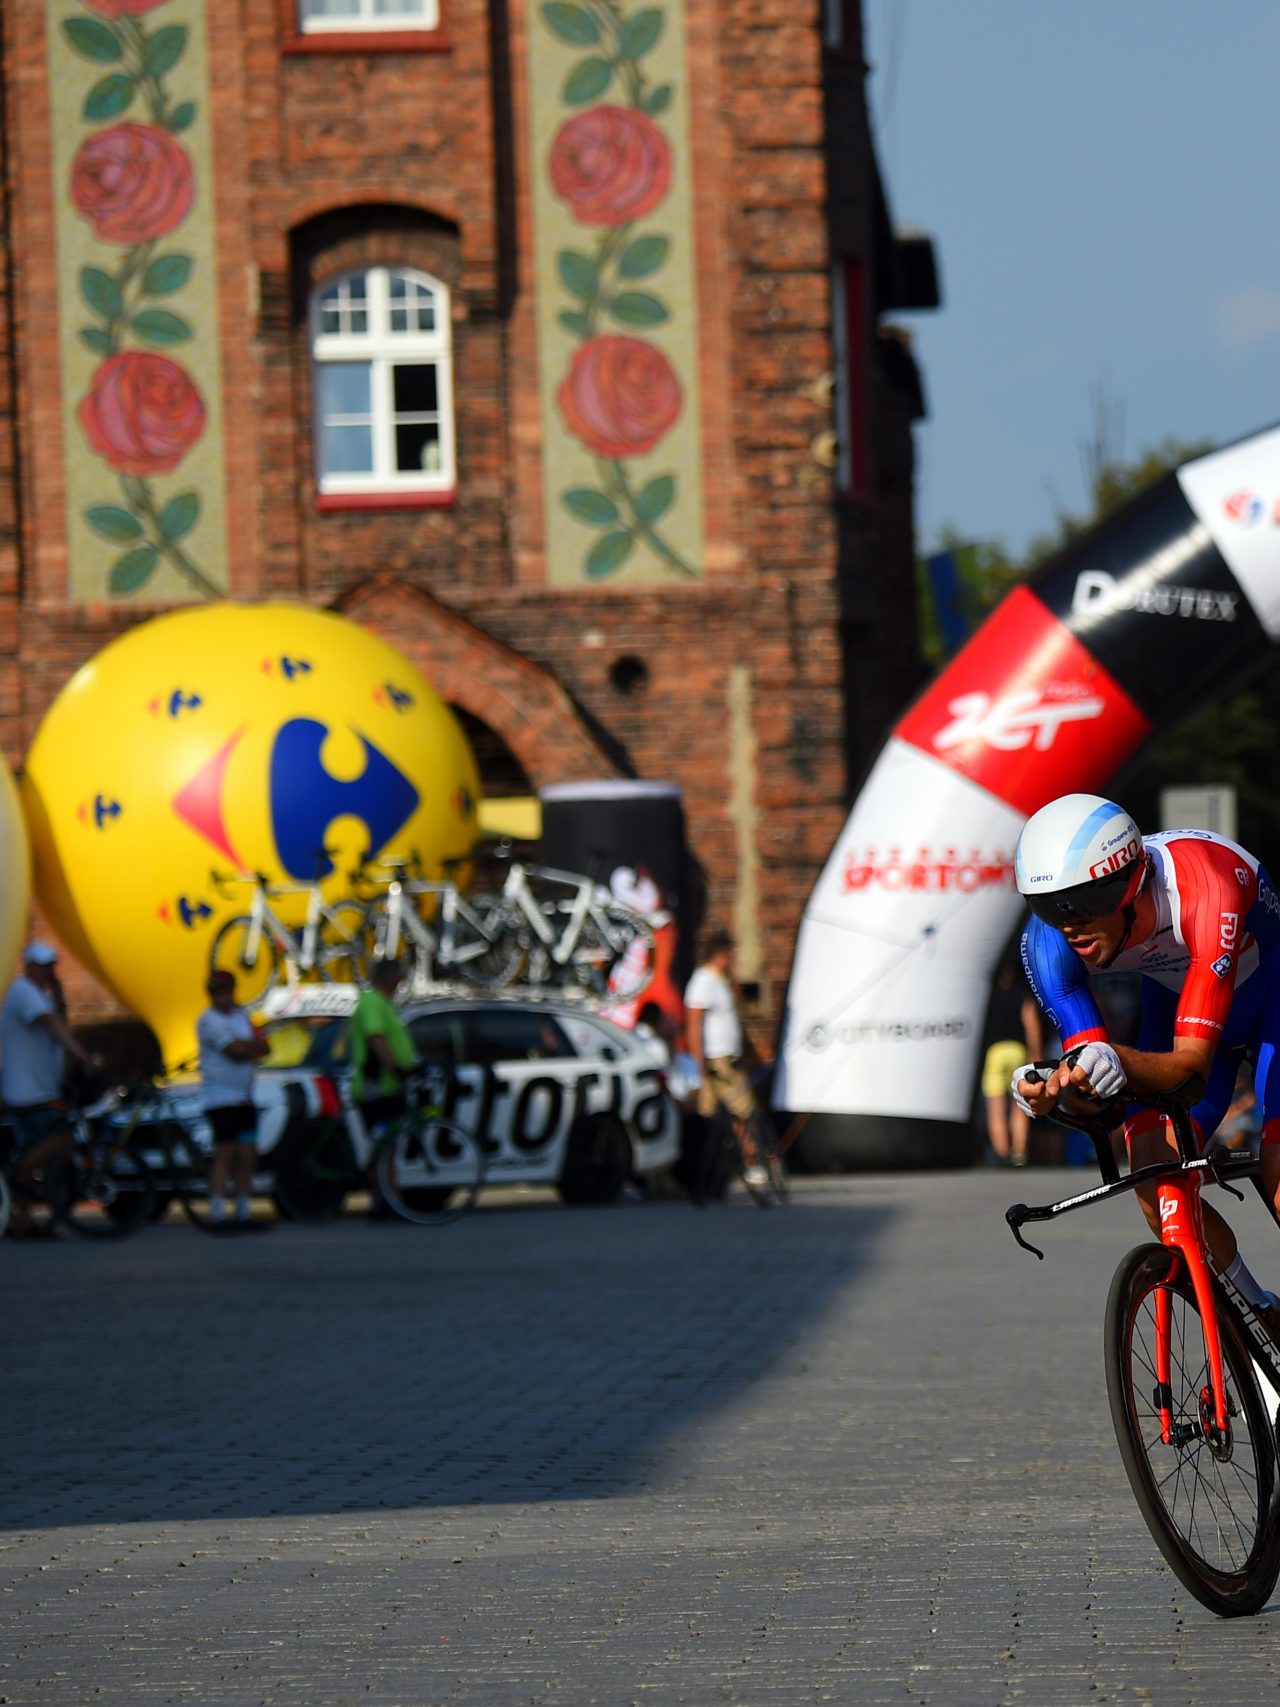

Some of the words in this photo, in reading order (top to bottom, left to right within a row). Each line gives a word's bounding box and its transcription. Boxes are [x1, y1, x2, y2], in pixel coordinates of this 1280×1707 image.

[1030, 874, 1053, 883] GIRO
[1088, 839, 1140, 880] GIRO
[1220, 911, 1239, 950] FDJ
